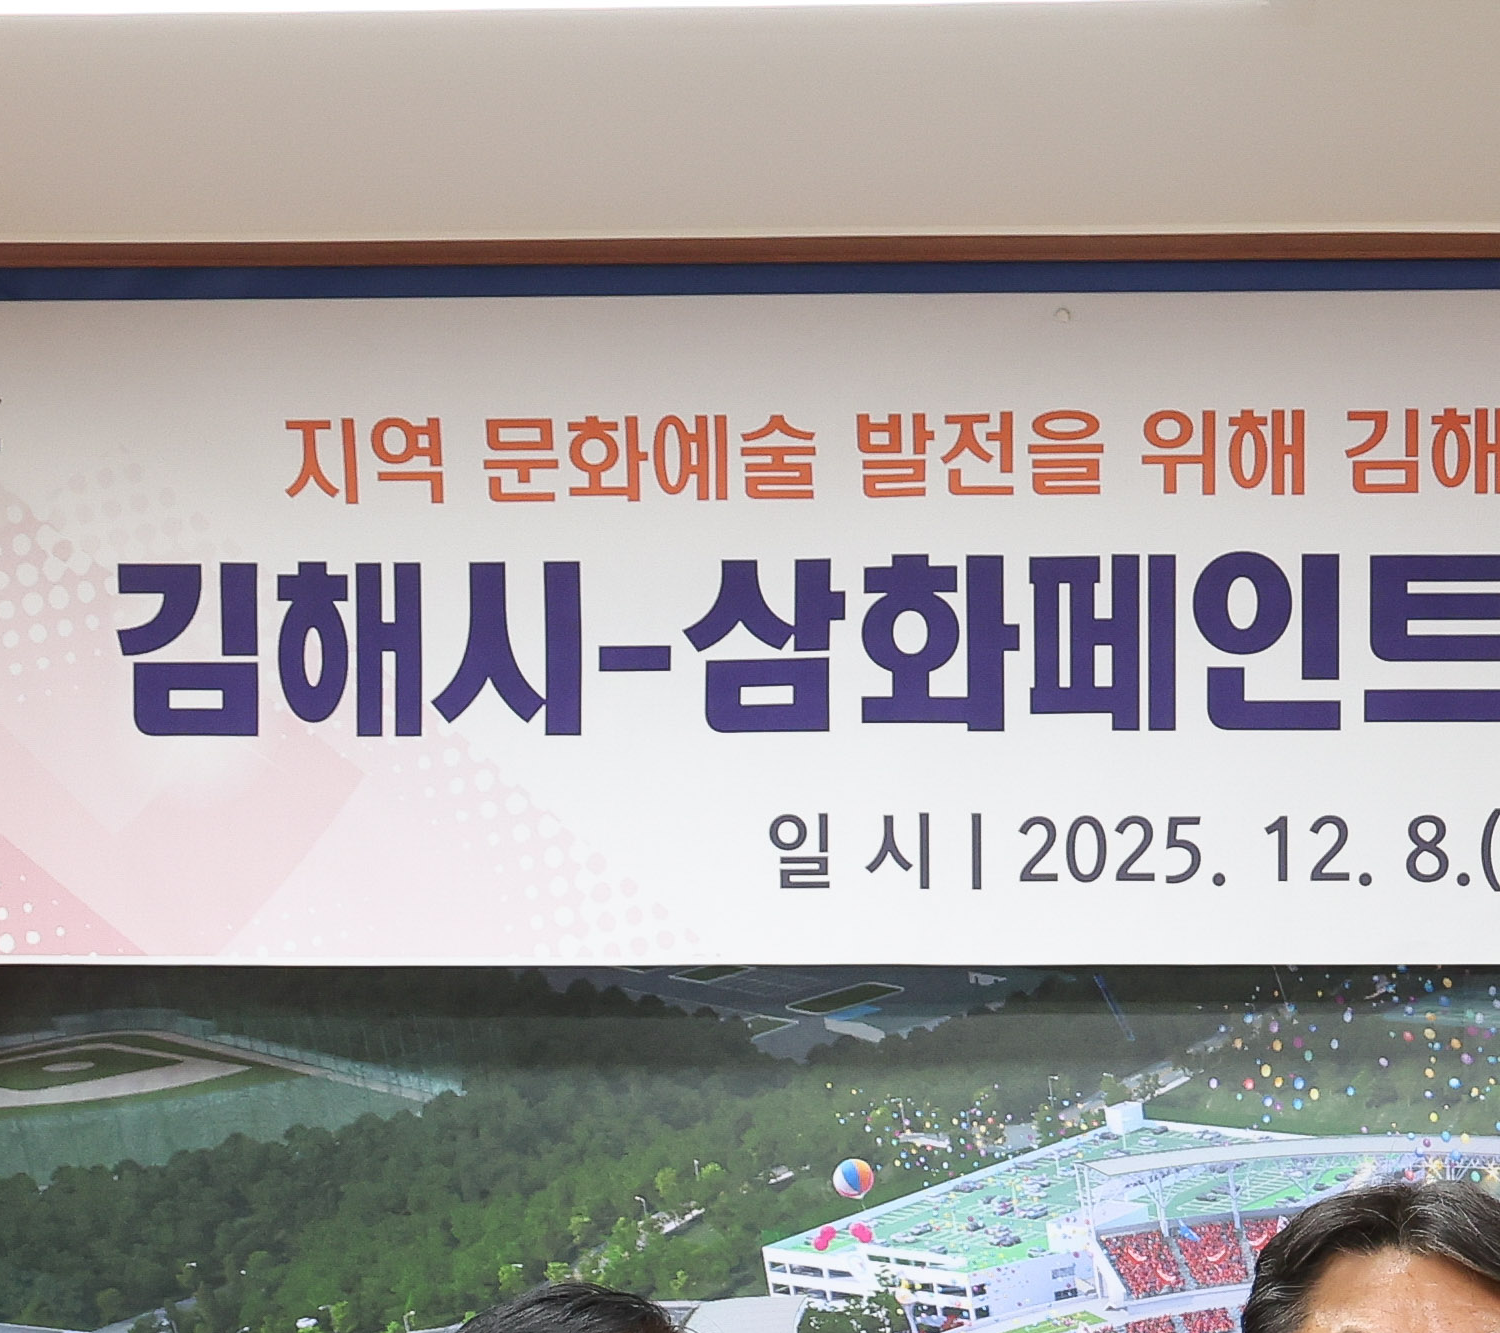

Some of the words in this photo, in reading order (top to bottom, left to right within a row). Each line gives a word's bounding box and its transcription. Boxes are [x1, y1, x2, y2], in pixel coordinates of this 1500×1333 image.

[285, 417, 444, 504] 지역
[483, 415, 816, 502] 문화예술
[856, 410, 1104, 498] 발전을
[1142, 409, 1305, 495] 위해
[1018, 815, 1225, 886] 2025.
[1264, 815, 1372, 886] 12.
